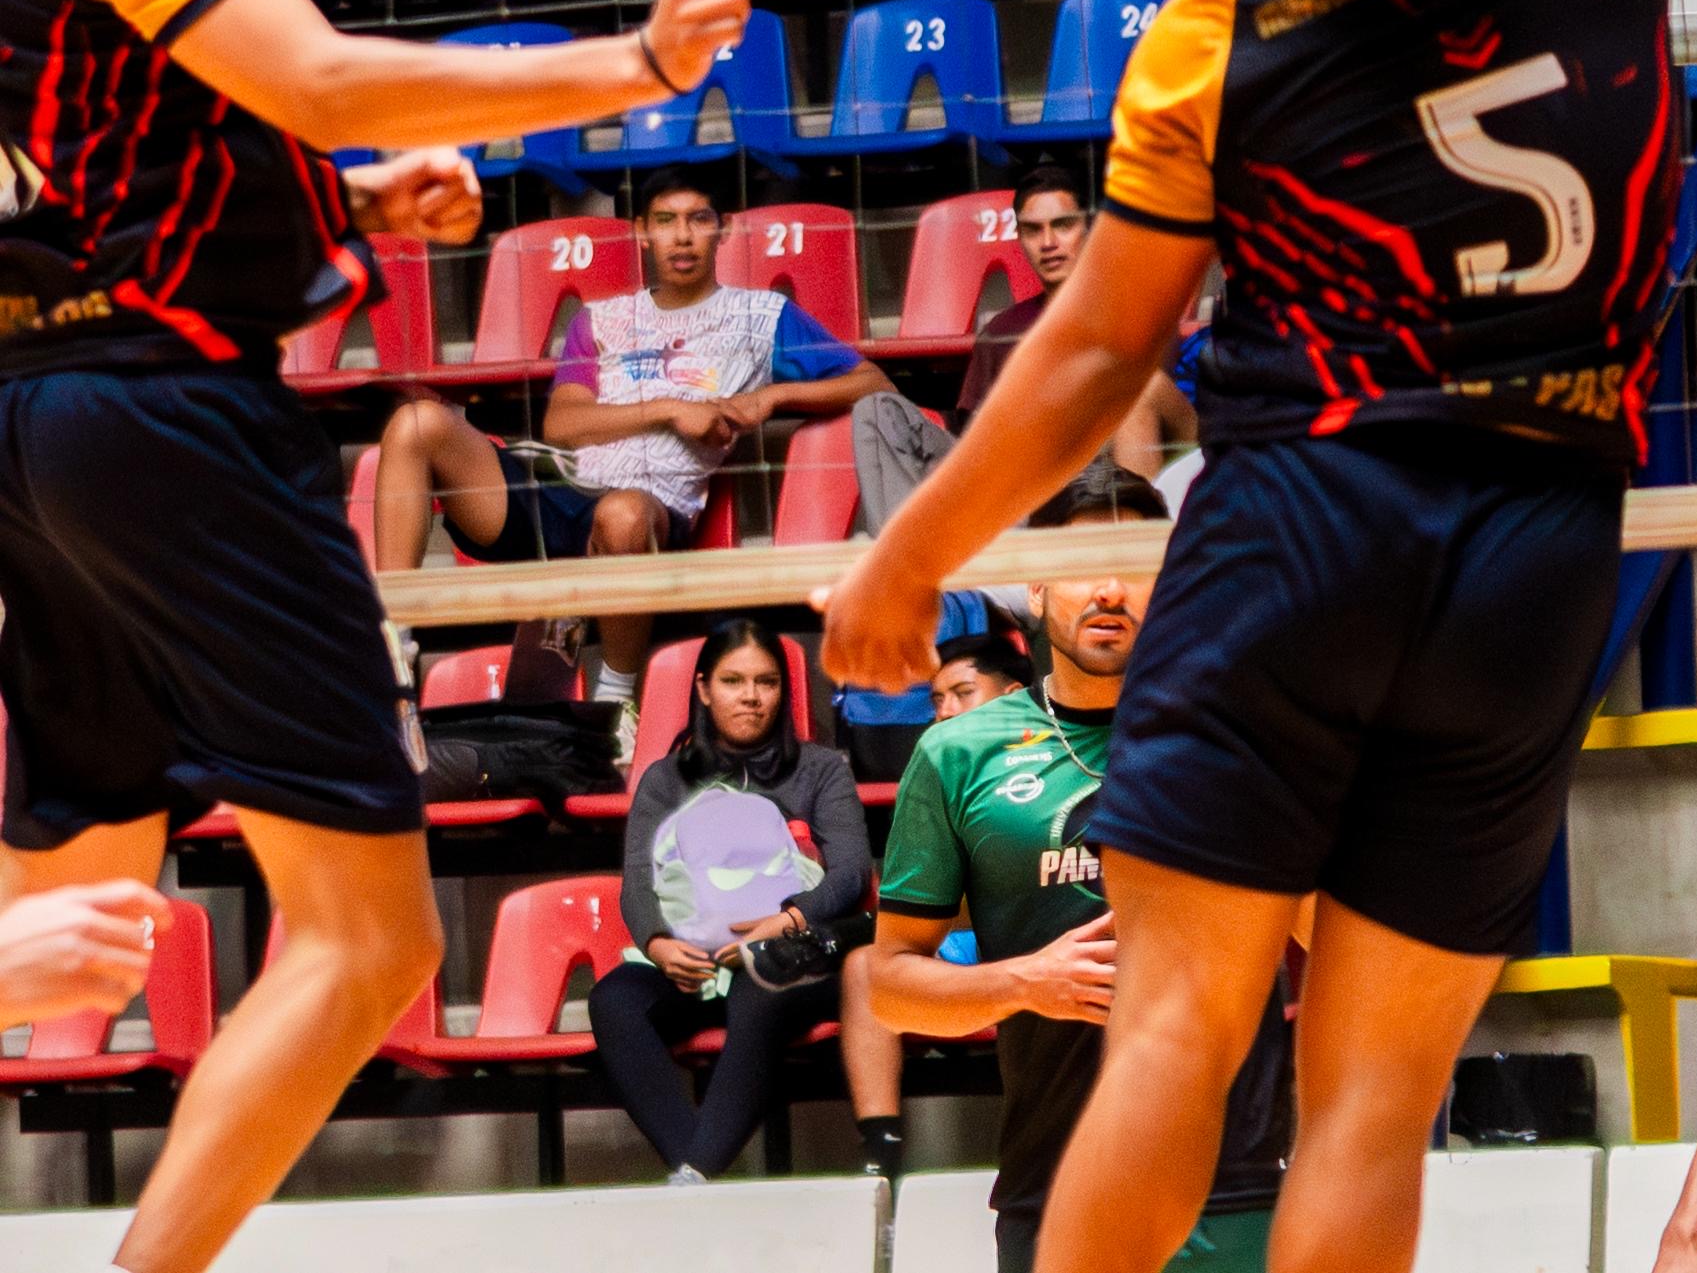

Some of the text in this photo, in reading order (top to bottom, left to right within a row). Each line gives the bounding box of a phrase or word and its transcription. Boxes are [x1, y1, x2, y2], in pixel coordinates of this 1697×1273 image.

[905, 17, 946, 52] 23
[1415, 52, 1596, 297] 5
[765, 220, 805, 258] 21
[978, 207, 1018, 243] 22
[551, 234, 594, 272] 20
